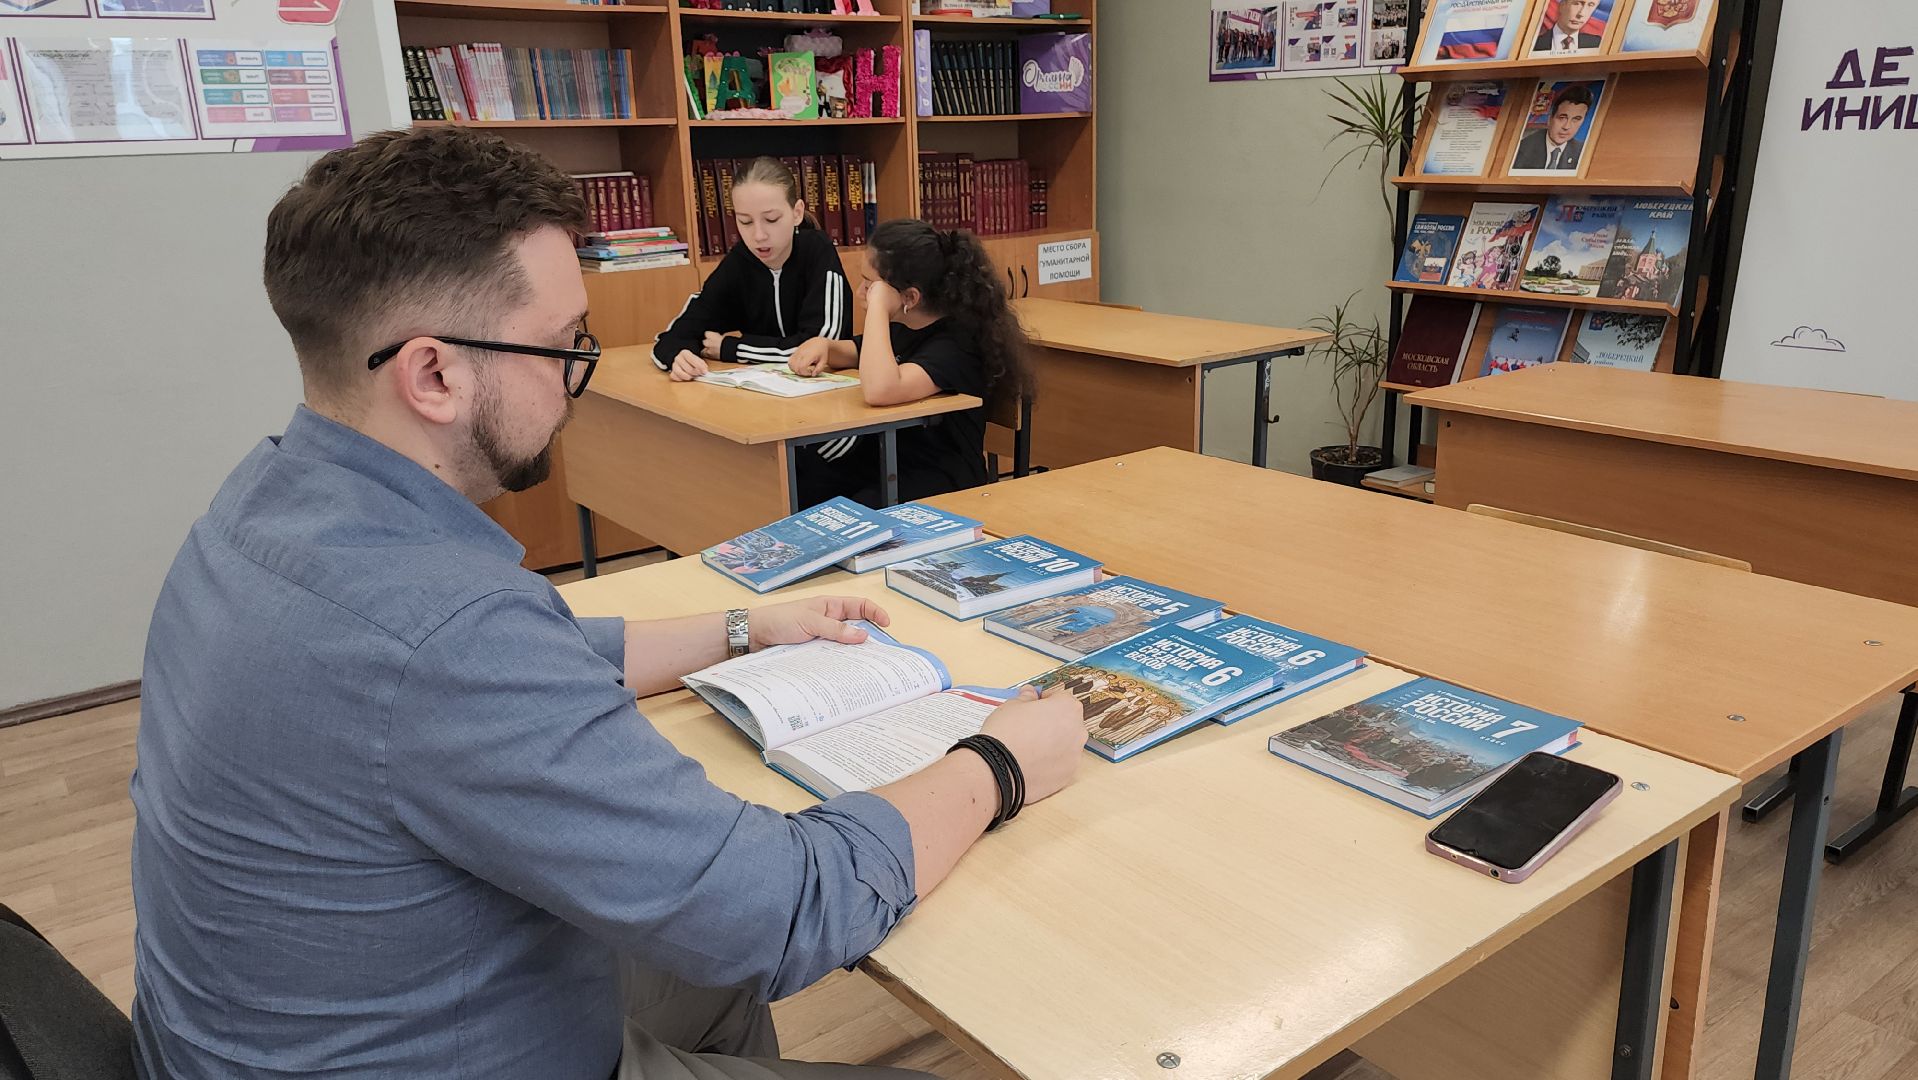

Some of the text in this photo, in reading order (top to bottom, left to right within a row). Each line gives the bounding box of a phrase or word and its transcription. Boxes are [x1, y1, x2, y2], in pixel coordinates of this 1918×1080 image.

[1825, 46, 1914, 89] ДЕ
[1649, 211, 1673, 219] КРАЙ
[1043, 242, 1086, 253] МЕСТО СБОРА
[1049, 269, 1081, 280] ПОМОЩИ
[1402, 352, 1450, 365] МОСКОВСКАЯ
[1407, 362, 1438, 373] ОБЛАСТЬ
[839, 521, 880, 540] 11
[924, 519, 965, 532] 11
[1037, 557, 1080, 573] 10
[1108, 584, 1172, 606] ИСТОРИЯ
[1152, 602, 1191, 616] 5
[1215, 631, 1290, 659] РОССИИ
[1231, 627, 1303, 652] ИСТОРИЯ
[1123, 650, 1168, 671] ВЕКОВ
[1138, 645, 1199, 672] СРЕДНИХ
[1151, 638, 1226, 670] ИСТОРИЯ
[1287, 649, 1327, 666] 6
[1201, 666, 1243, 687] 6
[1400, 700, 1493, 732] РОССИИ
[1417, 693, 1508, 724] ИСТОРИЯ
[1491, 720, 1540, 739] 7
